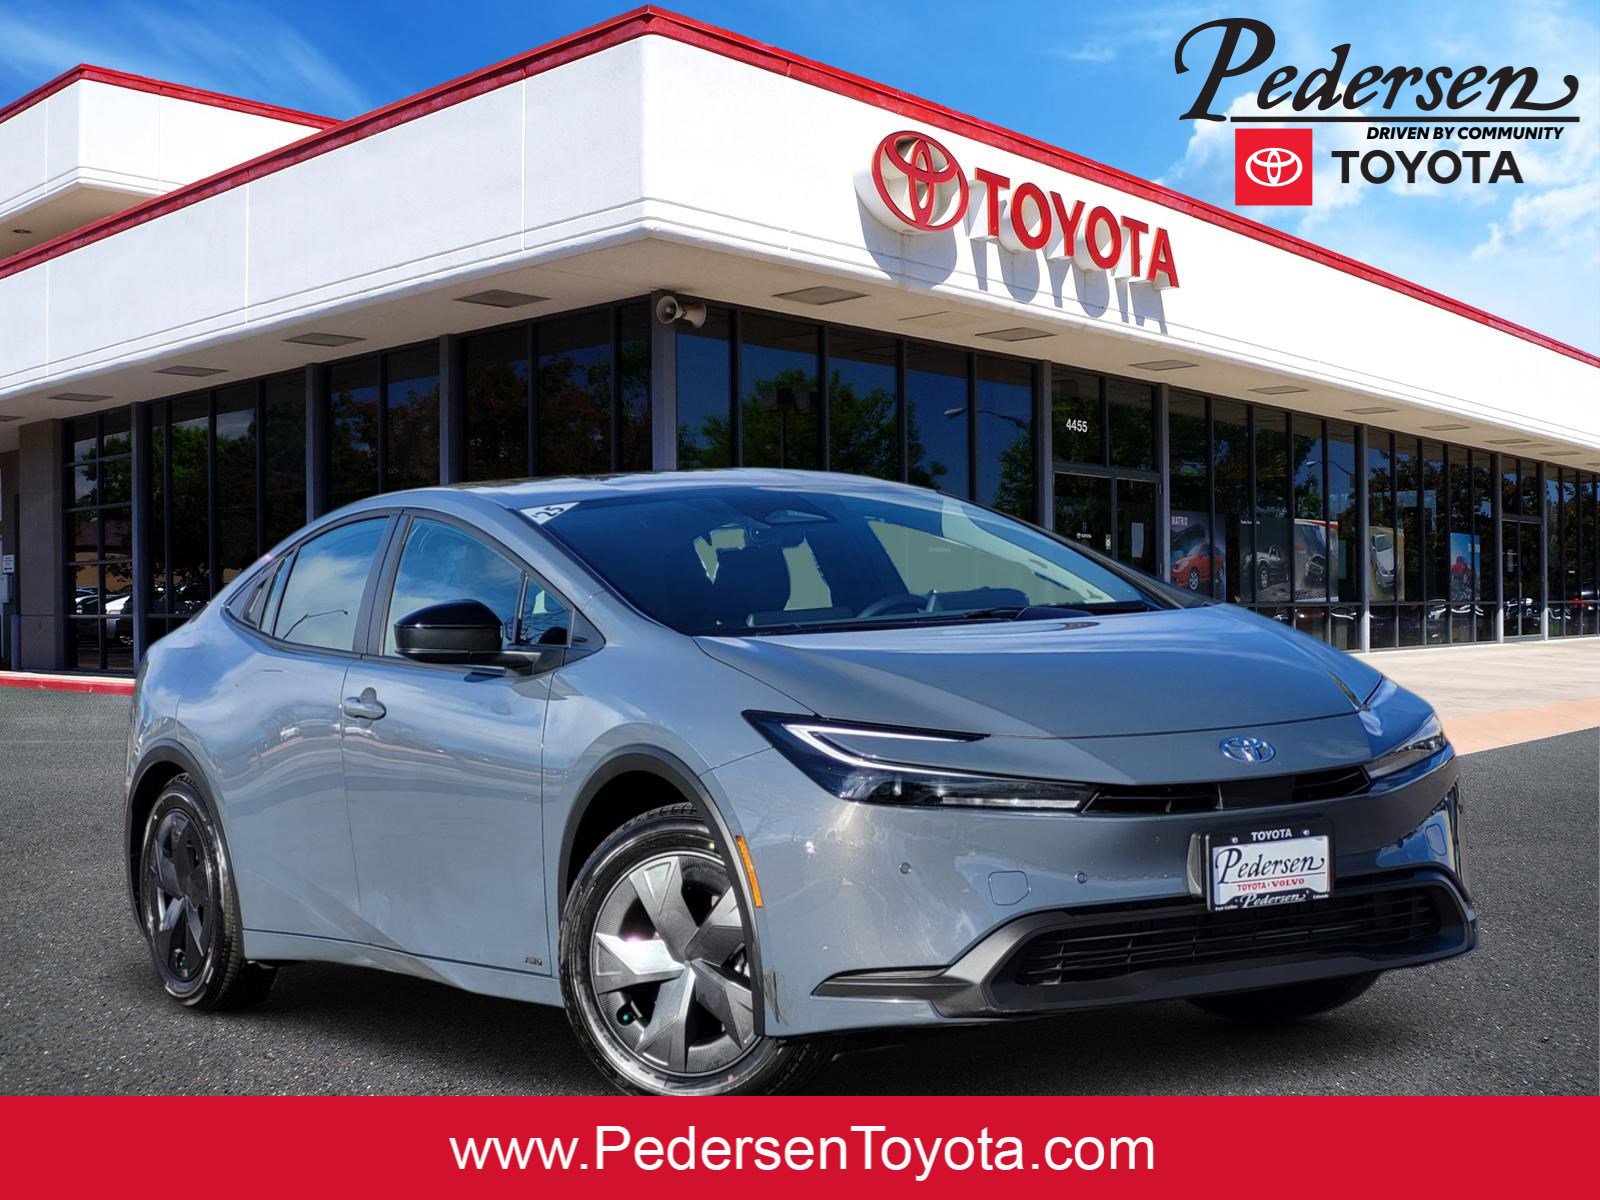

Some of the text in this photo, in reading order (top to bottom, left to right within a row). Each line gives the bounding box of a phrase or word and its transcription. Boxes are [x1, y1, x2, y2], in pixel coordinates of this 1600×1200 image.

[974, 167, 1180, 288] TOYOTA
[1065, 418, 1088, 433] 4455
[1251, 828, 1292, 842] TOYOTA
[1215, 847, 1325, 885] Pedersen
[1237, 878, 1305, 891] TOYOTA VOLVO
[1240, 892, 1306, 909] Pedersen
